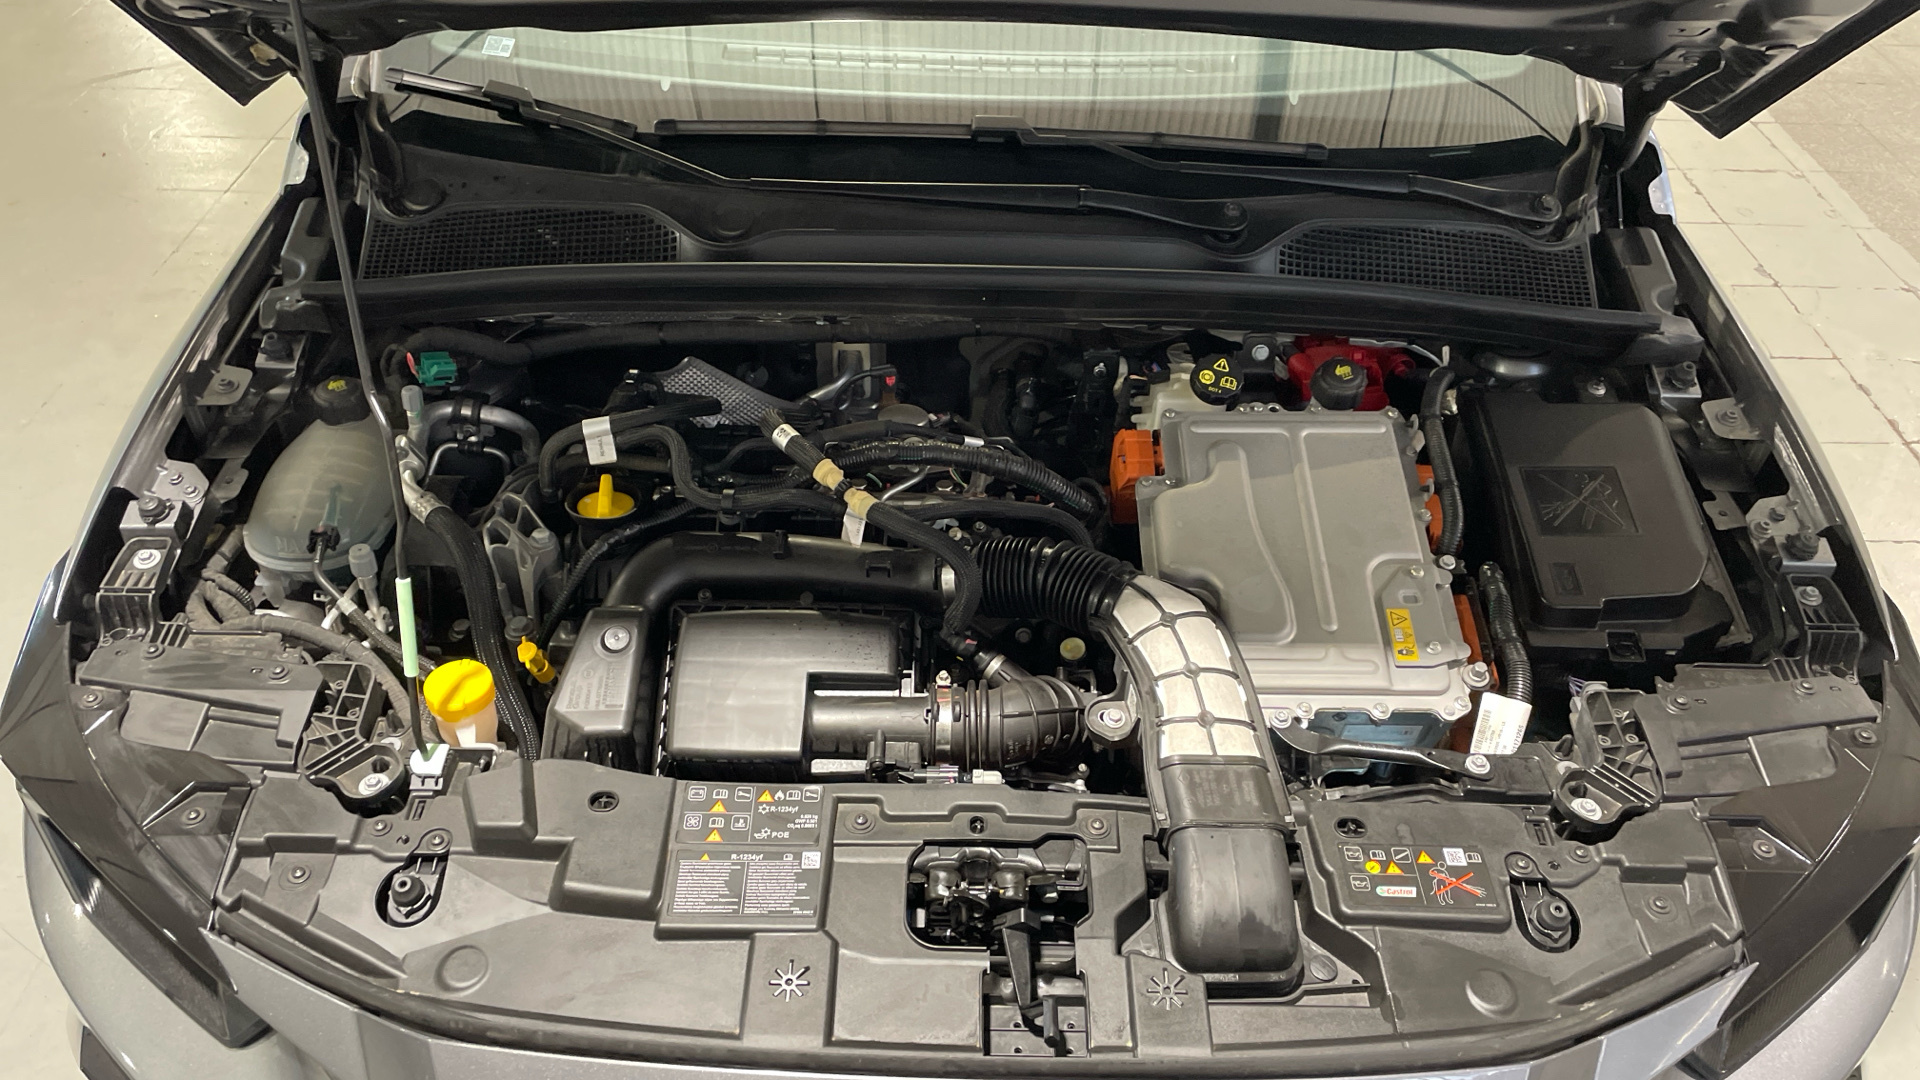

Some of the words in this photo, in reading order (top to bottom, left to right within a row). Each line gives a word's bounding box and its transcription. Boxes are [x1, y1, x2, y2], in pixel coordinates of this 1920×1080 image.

[770, 805, 799, 814] R-1234yf
[771, 831, 790, 839] POE
[730, 853, 764, 862] R-1234yf
[1386, 887, 1413, 895] Castrol
